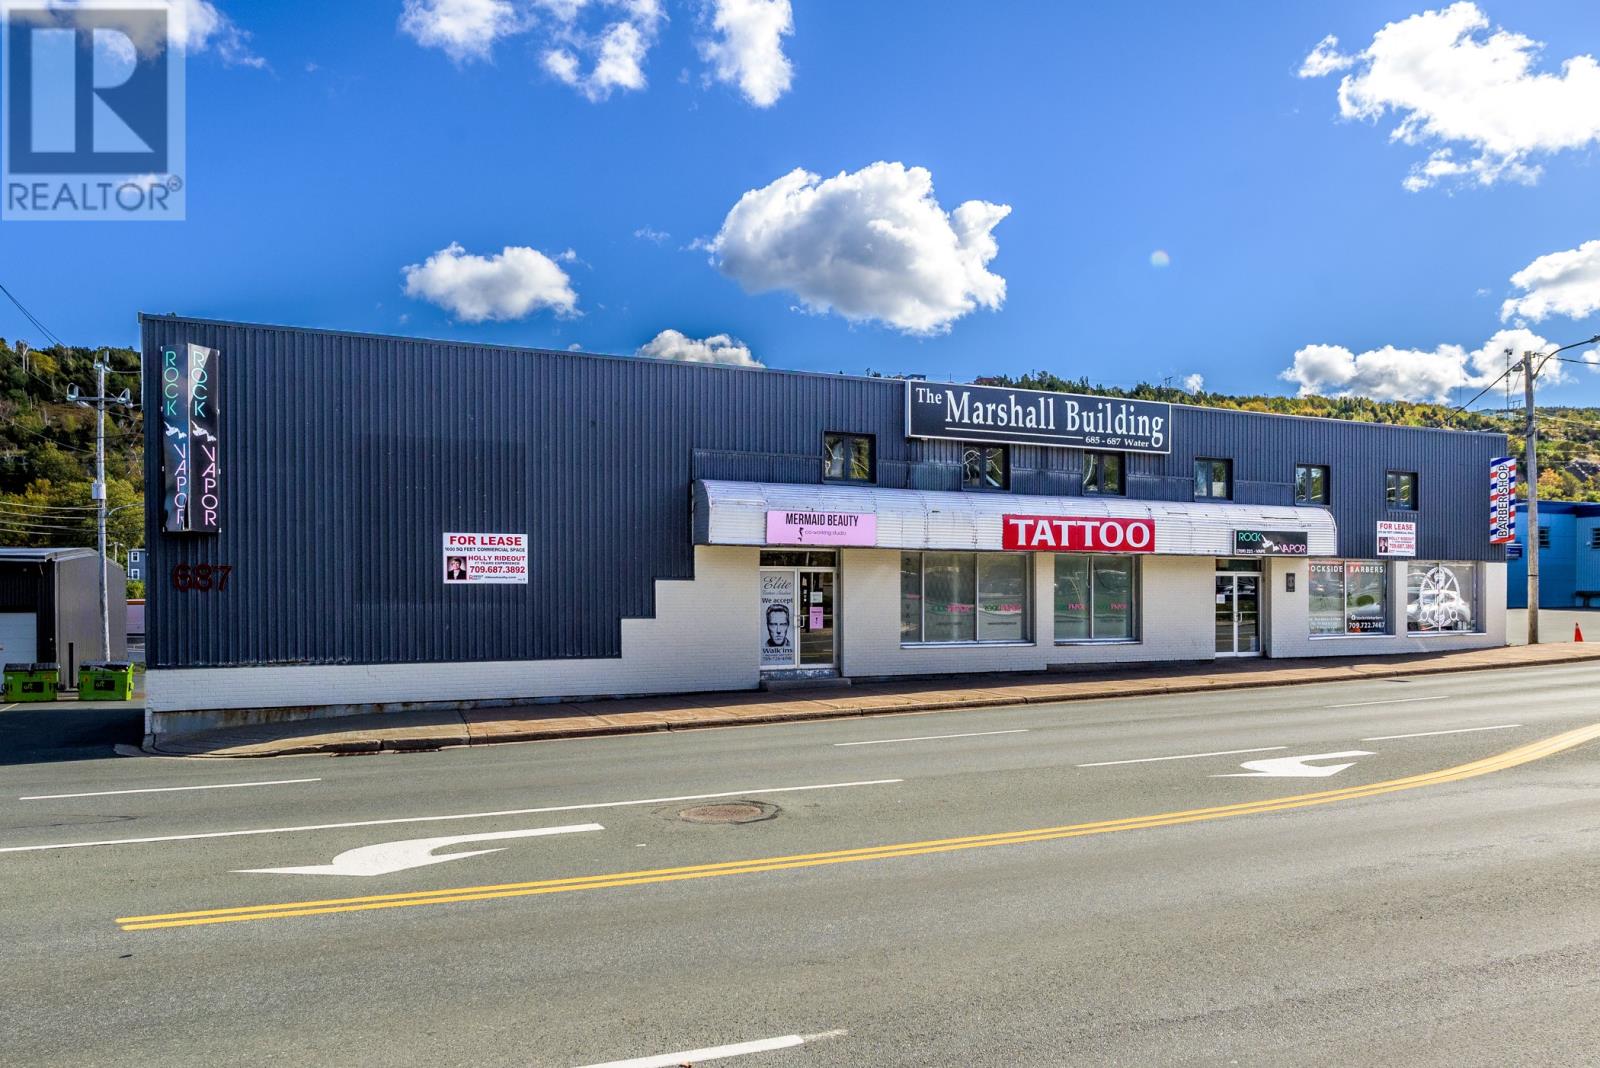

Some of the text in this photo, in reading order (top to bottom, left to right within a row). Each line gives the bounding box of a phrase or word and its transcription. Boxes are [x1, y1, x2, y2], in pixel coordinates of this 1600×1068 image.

[164, 350, 179, 416] ROCK
[191, 350, 207, 418] ROCK
[915, 387, 1164, 447] The Marshall Building
[1085, 436, 1100, 444] 685
[1107, 437, 1121, 446] 687
[1124, 438, 1149, 448] Water
[201, 444, 218, 526] VAPOR
[785, 513, 859, 527] MERMAID BEAUTY
[449, 535, 522, 546] FOR LEASE
[1009, 519, 1150, 548] TATTOO
[1238, 532, 1261, 542] ROCK
[1279, 544, 1306, 553] VAPOR
[469, 565, 526, 574] 709.687.3892
[1310, 565, 1344, 573] OCKSIDE
[173, 563, 232, 593] 687
